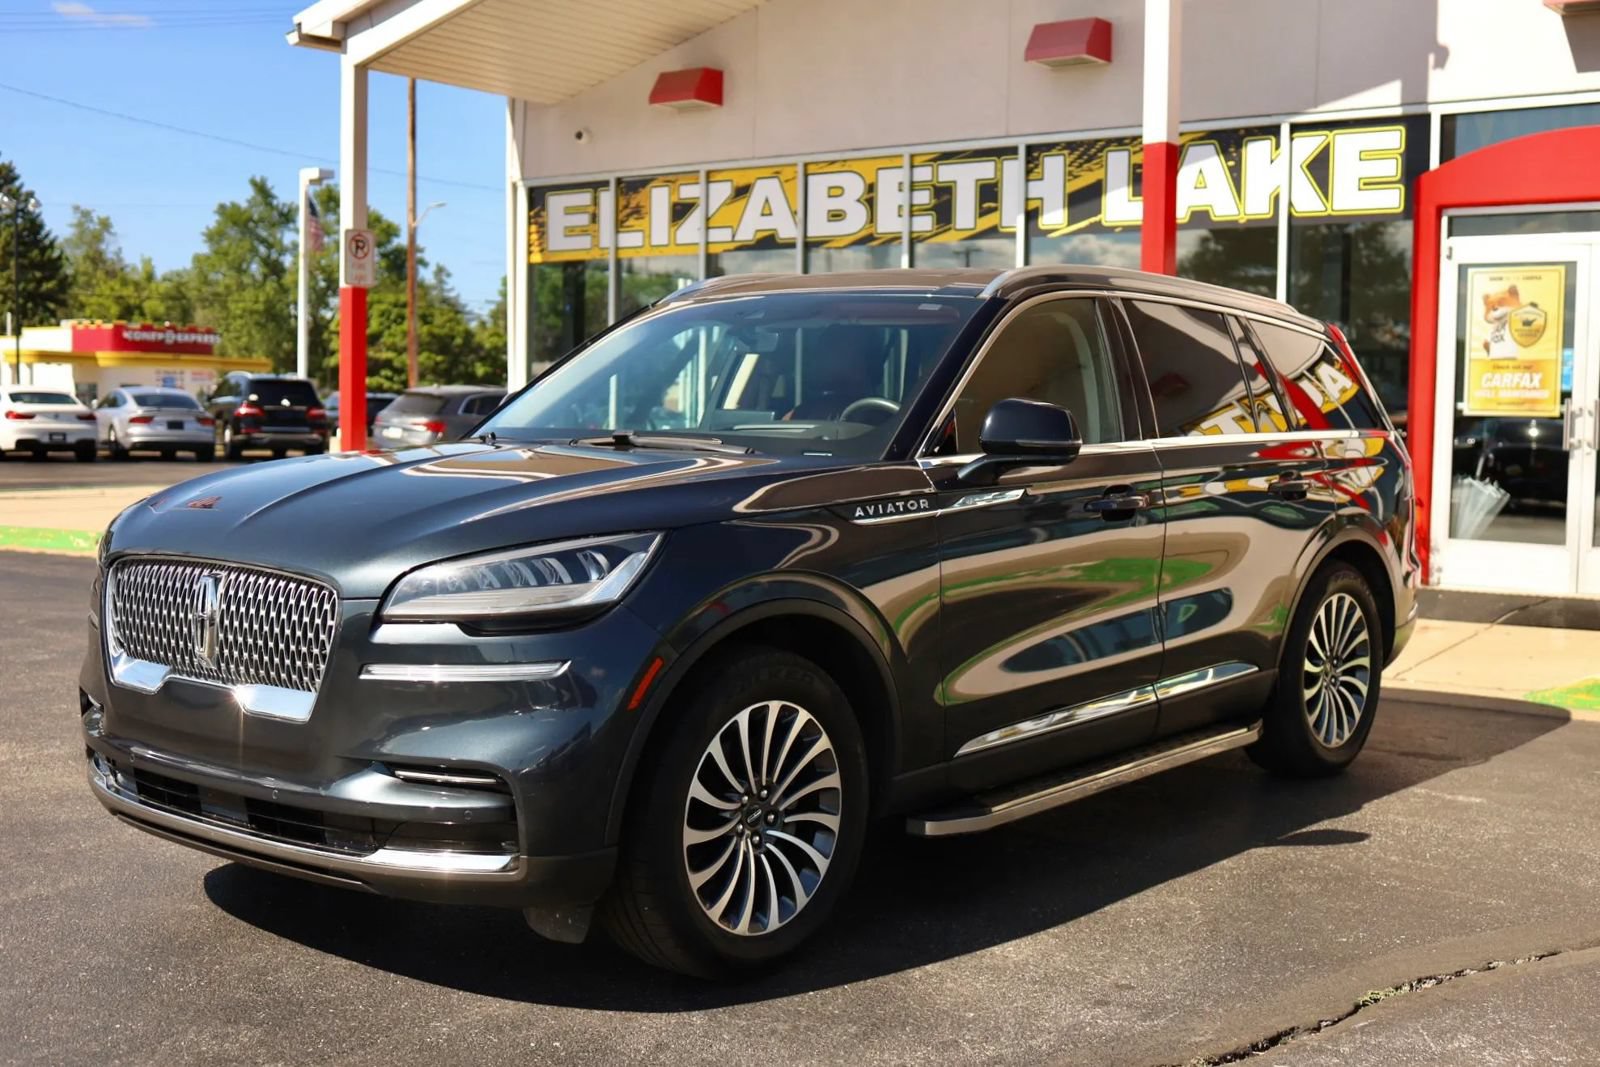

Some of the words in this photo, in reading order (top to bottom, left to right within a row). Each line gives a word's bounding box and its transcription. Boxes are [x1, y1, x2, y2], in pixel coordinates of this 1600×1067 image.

[546, 153, 1067, 251] ELIZABETH
[1102, 126, 1405, 226] LAKE
[1482, 372, 1543, 389] CARFAX
[855, 499, 929, 517] AVIATOR
